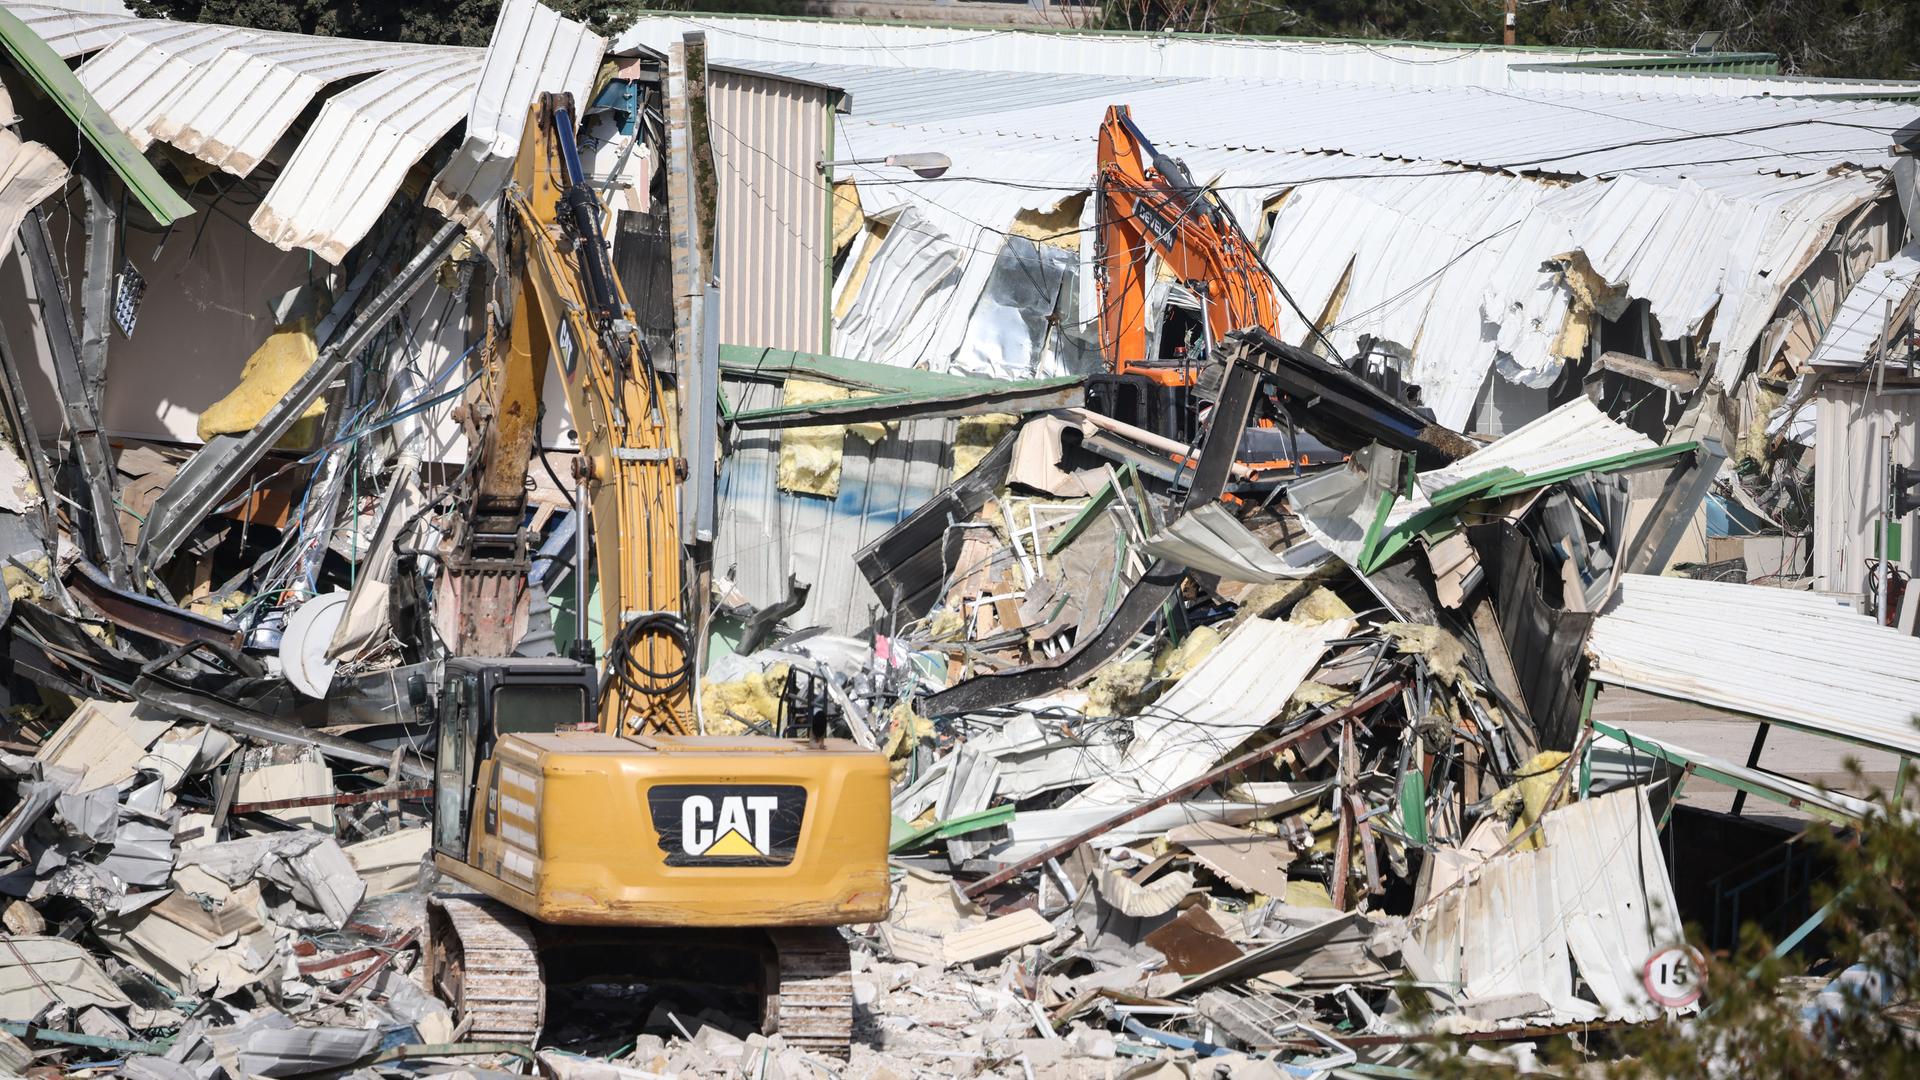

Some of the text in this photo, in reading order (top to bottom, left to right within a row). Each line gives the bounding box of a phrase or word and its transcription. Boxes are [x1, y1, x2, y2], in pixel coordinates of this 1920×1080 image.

[560, 319, 573, 371] CAT
[681, 794, 778, 856] CAT
[1660, 961, 1688, 986] 15
